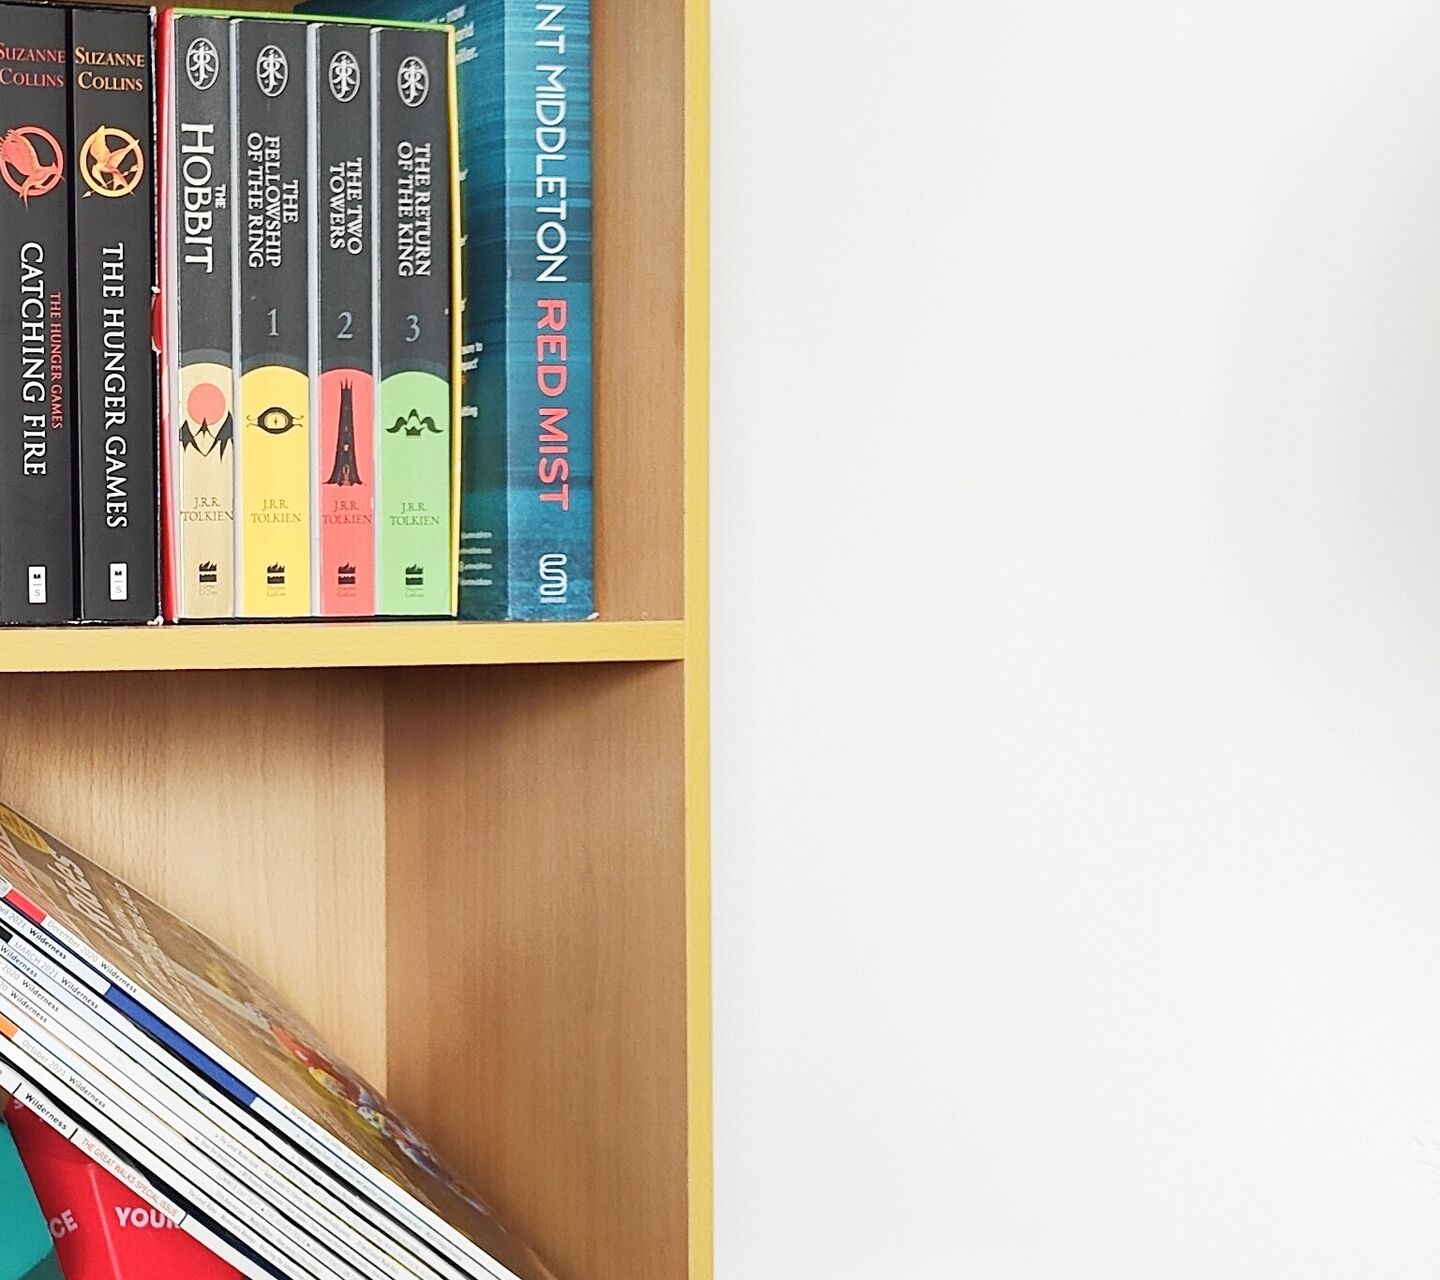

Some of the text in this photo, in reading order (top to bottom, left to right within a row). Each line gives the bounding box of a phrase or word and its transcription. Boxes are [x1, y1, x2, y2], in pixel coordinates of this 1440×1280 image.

[182, 122, 215, 273] HOBBIT
[215, 184, 227, 210] THE
[248, 132, 264, 269] OF THE RING
[264, 135, 281, 267] FELLOWSHIP
[282, 179, 298, 224] THE
[329, 161, 346, 249] TOWERS
[347, 157, 363, 255] THE TWO
[397, 141, 414, 277] OF THE KING
[414, 142, 431, 276] THE RETURN
[536, 65, 567, 282] MIDDLETON
[20, 241, 47, 476] CATCHING FIRE
[267, 309, 280, 337] 1
[337, 312, 354, 339] 2
[405, 315, 421, 342] 3
[49, 291, 63, 429] THE HUNGER GAMES
[102, 242, 128, 528] THE HUNGER GAMES
[536, 298, 569, 511] RED MIST
[180, 510, 234, 522] TOLKIEN
[250, 512, 302, 524] TOLKIEN
[322, 513, 372, 525] TOLKIEN
[389, 514, 440, 526] TOLKIEN
[12, 939, 38, 962] MARCH
[59, 975, 100, 1010] Wilderness
[27, 926, 68, 961] Wilderness
[45, 919, 78, 946] December
[98, 960, 139, 994] Wilderness
[8, 989, 49, 1024] Wilderness
[19, 978, 61, 1013] Wilderness
[20, 1038, 50, 1063] October
[66, 1074, 108, 1109] Wilderness
[22, 1090, 70, 1131] Wilderness
[80, 1137, 180, 1217] THE GREAT WALKS SPECIAL ISSUE
[49, 1208, 79, 1239] CE
